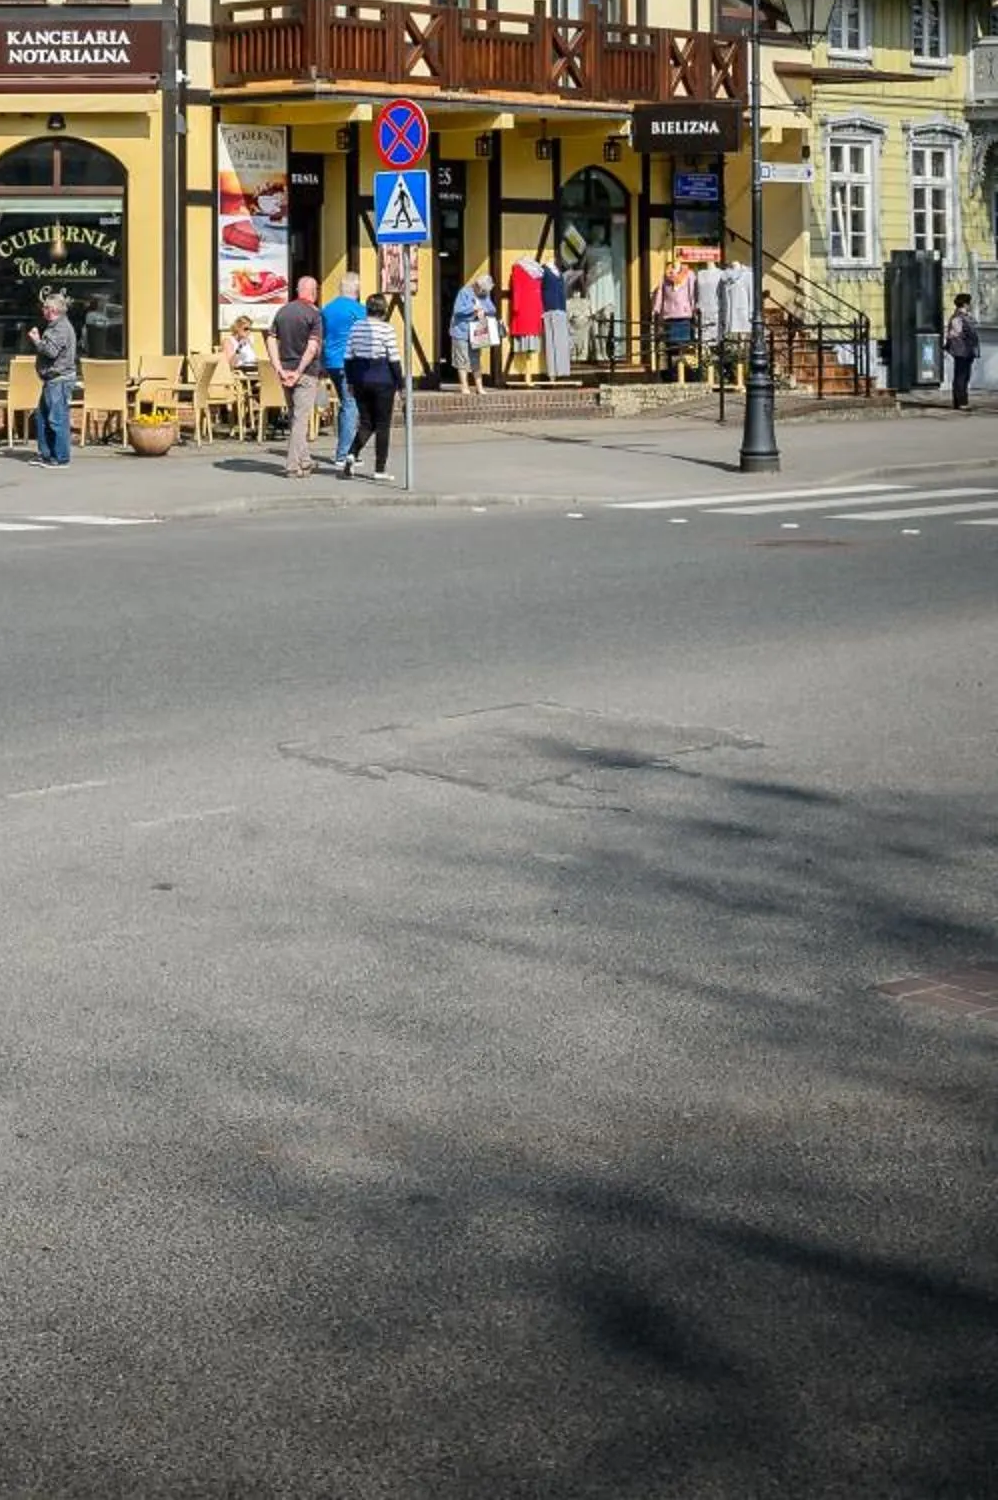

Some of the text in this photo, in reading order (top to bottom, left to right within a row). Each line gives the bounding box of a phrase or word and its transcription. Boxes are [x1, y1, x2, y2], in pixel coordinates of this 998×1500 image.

[6, 30, 131, 45] KANCELARIA
[8, 49, 131, 63] NOTARIALNA
[651, 121, 720, 135] BIELIZNA
